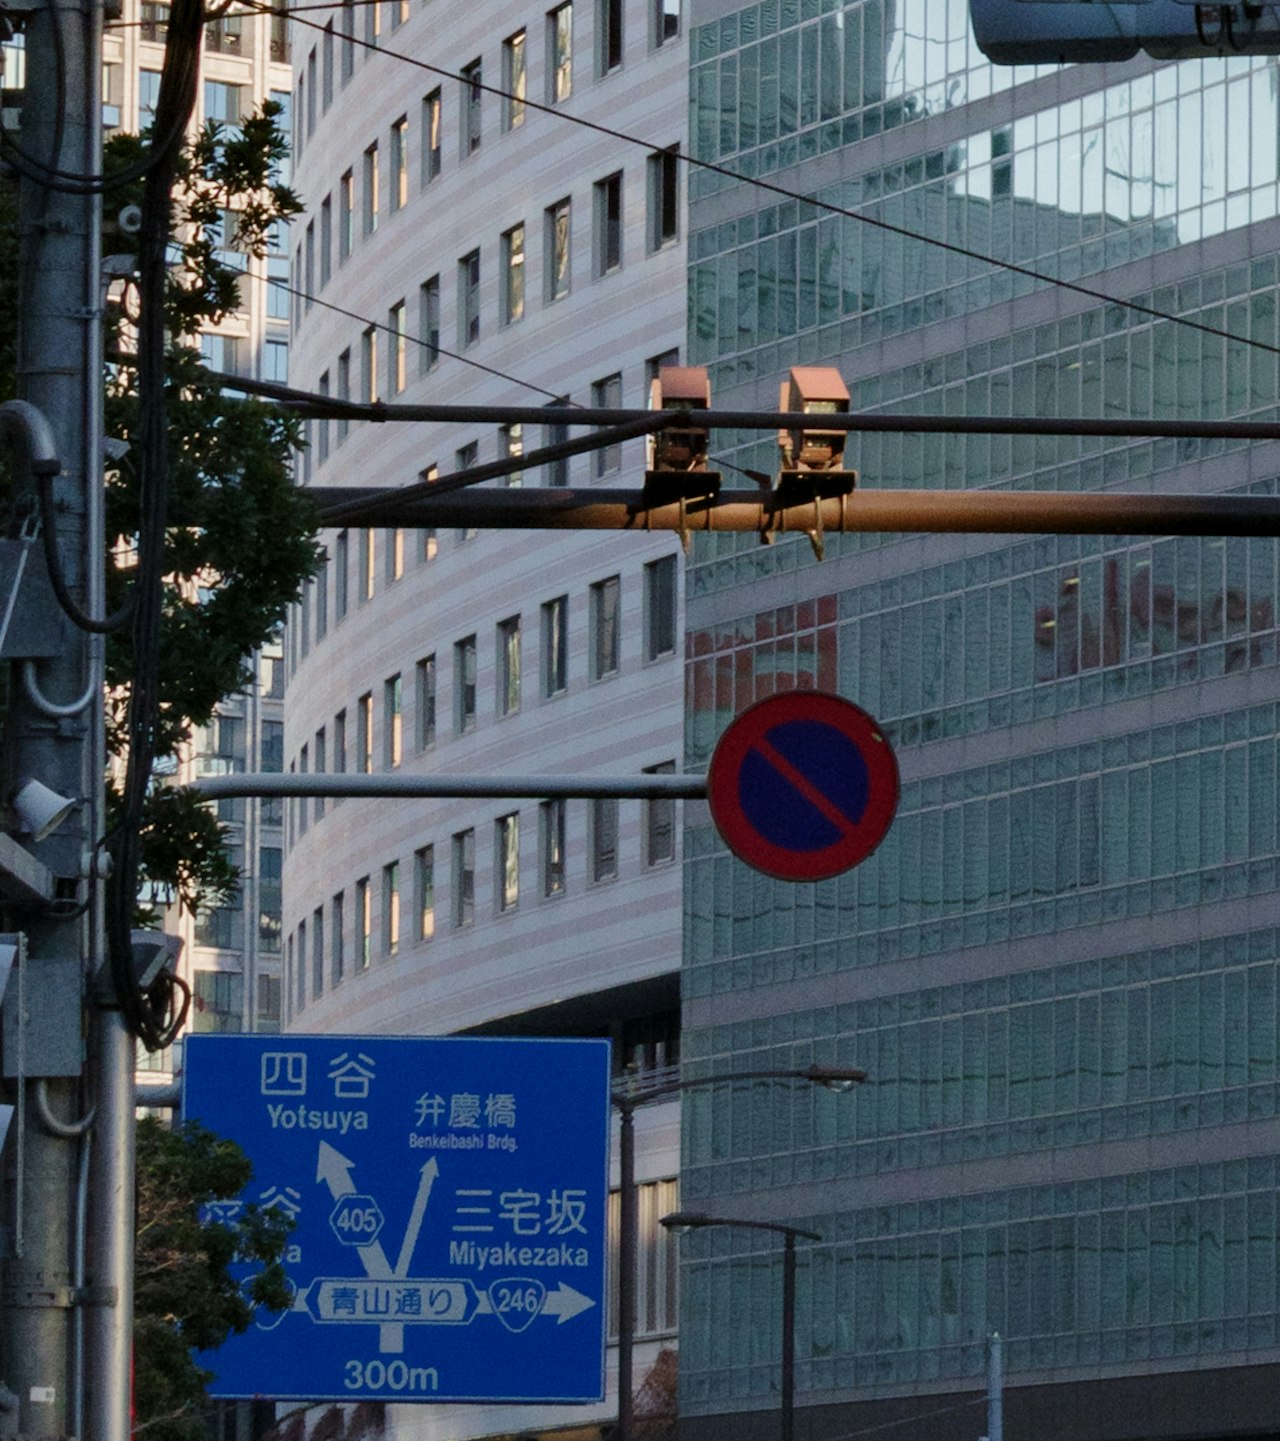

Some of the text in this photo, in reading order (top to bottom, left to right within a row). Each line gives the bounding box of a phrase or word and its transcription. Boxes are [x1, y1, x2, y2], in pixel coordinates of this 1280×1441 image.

[261, 1052, 376, 1098] 四谷
[268, 1105, 368, 1133] Yotsuya
[415, 1093, 516, 1128] 弁慶橋
[409, 1134, 517, 1151] Benkeibashi Brdg.
[337, 1209, 376, 1231] 405
[453, 1189, 588, 1235] 三宅坂
[450, 1240, 589, 1270] Miyakezaka
[331, 1287, 452, 1315] 青山通り
[499, 1288, 537, 1312] 246
[344, 1361, 438, 1390] 300m
